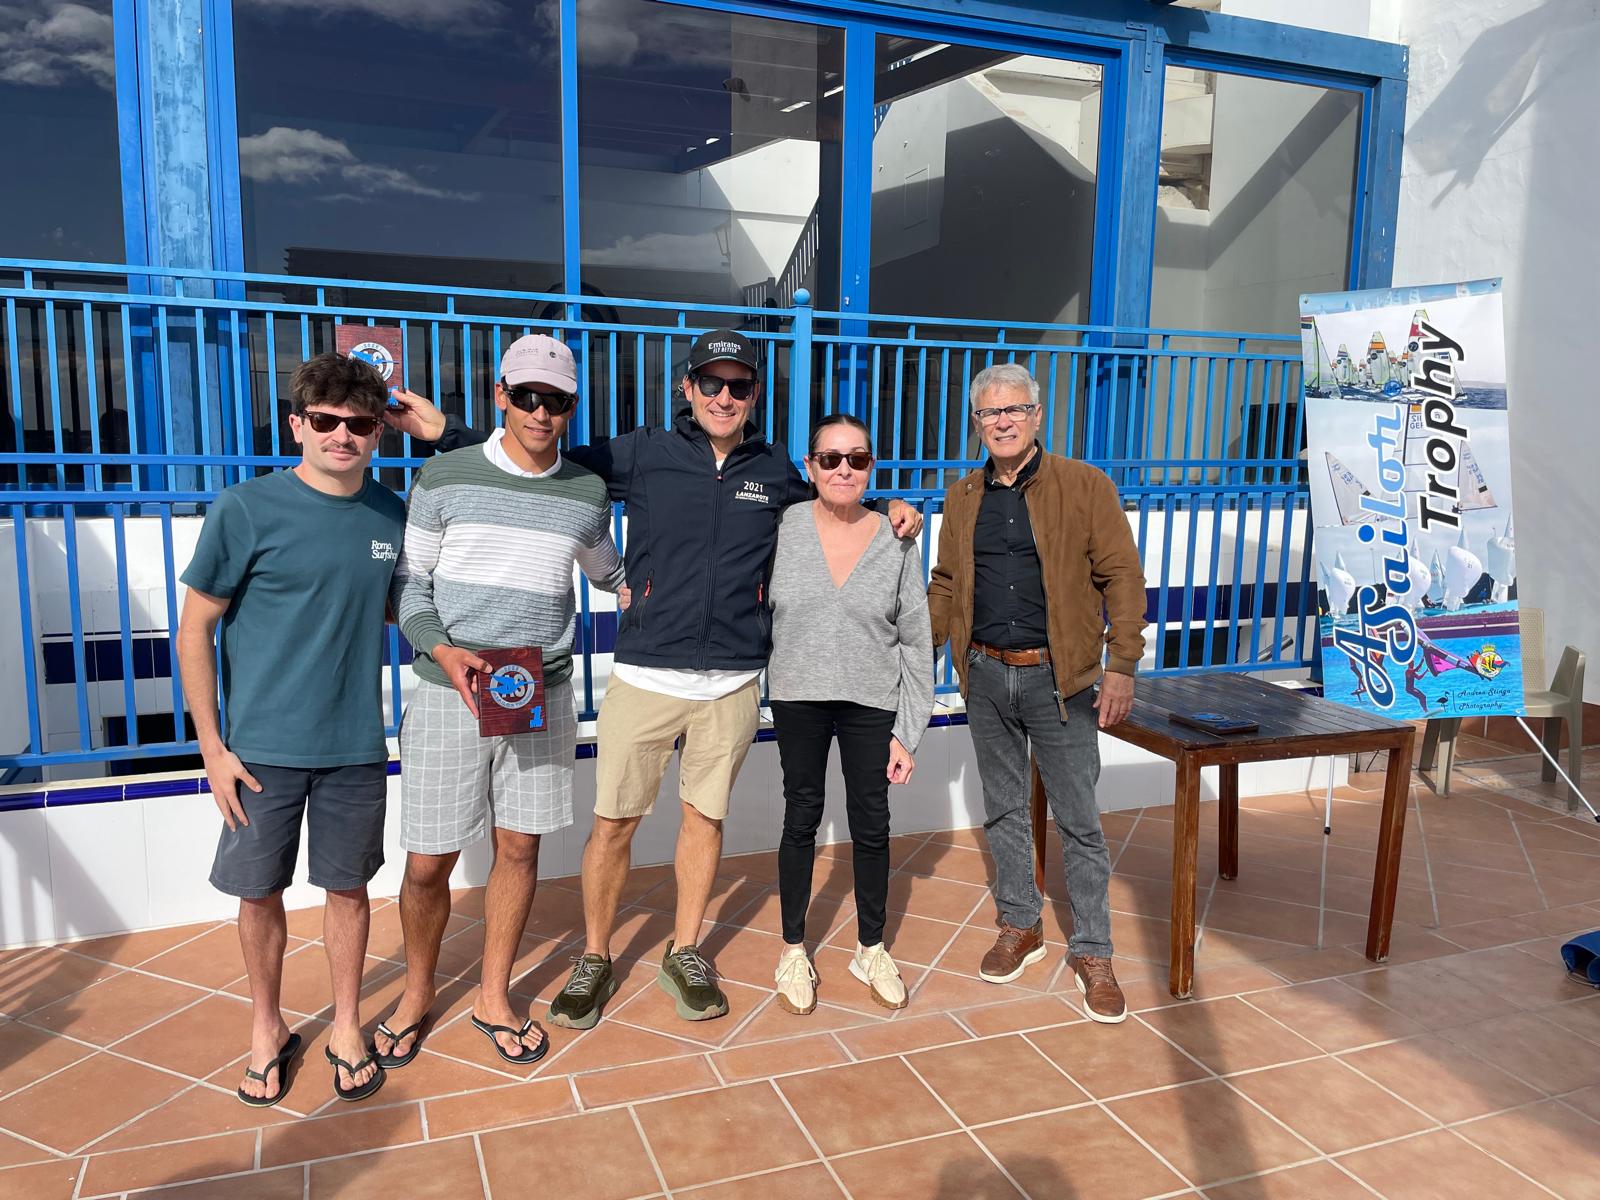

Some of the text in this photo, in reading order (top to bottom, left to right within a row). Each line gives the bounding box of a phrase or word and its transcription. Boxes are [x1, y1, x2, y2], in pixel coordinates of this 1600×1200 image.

[708, 340, 741, 350] Emirates
[1411, 319, 1469, 531] Trophy
[743, 480, 763, 493] 2021
[735, 490, 769, 501] LANZAROTE
[1334, 626, 1394, 708] A
[1458, 700, 1503, 711] Photography
[530, 705, 544, 728] 1
